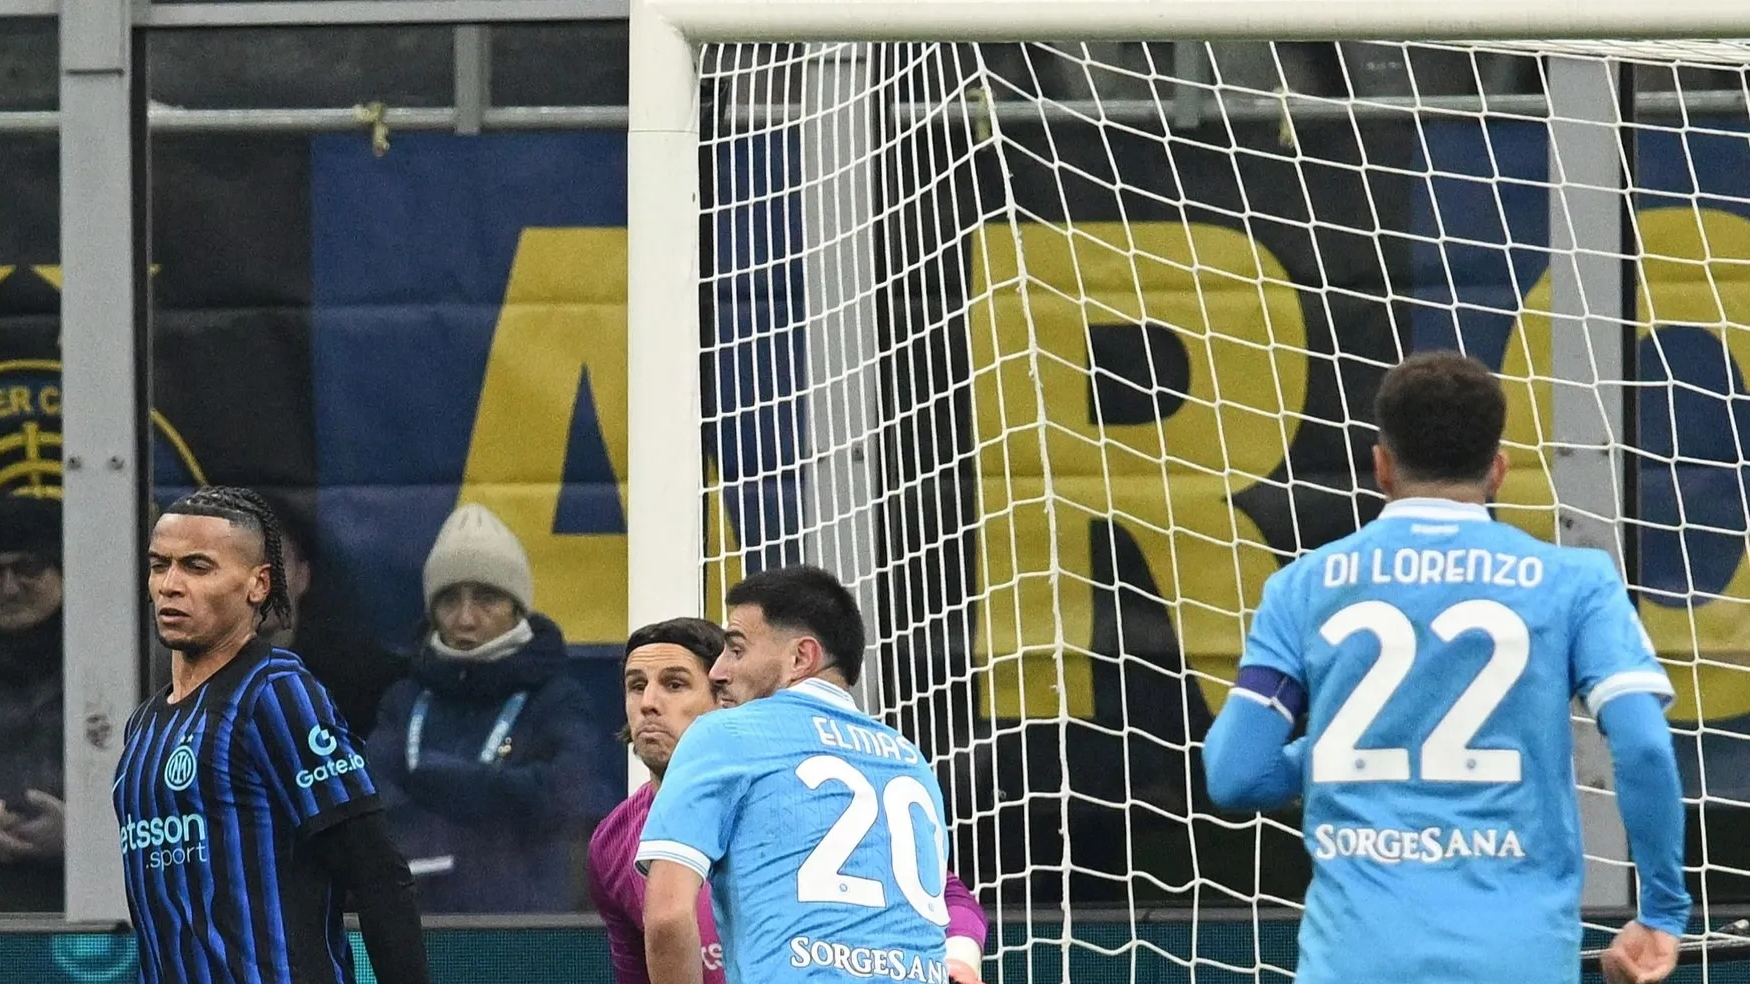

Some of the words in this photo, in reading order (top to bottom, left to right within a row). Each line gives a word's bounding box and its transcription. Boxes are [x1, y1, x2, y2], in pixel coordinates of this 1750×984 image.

[1323, 553, 1358, 587] DI
[1372, 547, 1544, 588] LORENZO
[1312, 598, 1531, 783] 22
[812, 715, 919, 765] ELMAS
[295, 753, 367, 789] Gate.io
[120, 813, 207, 855] etsson
[794, 754, 952, 928] 20
